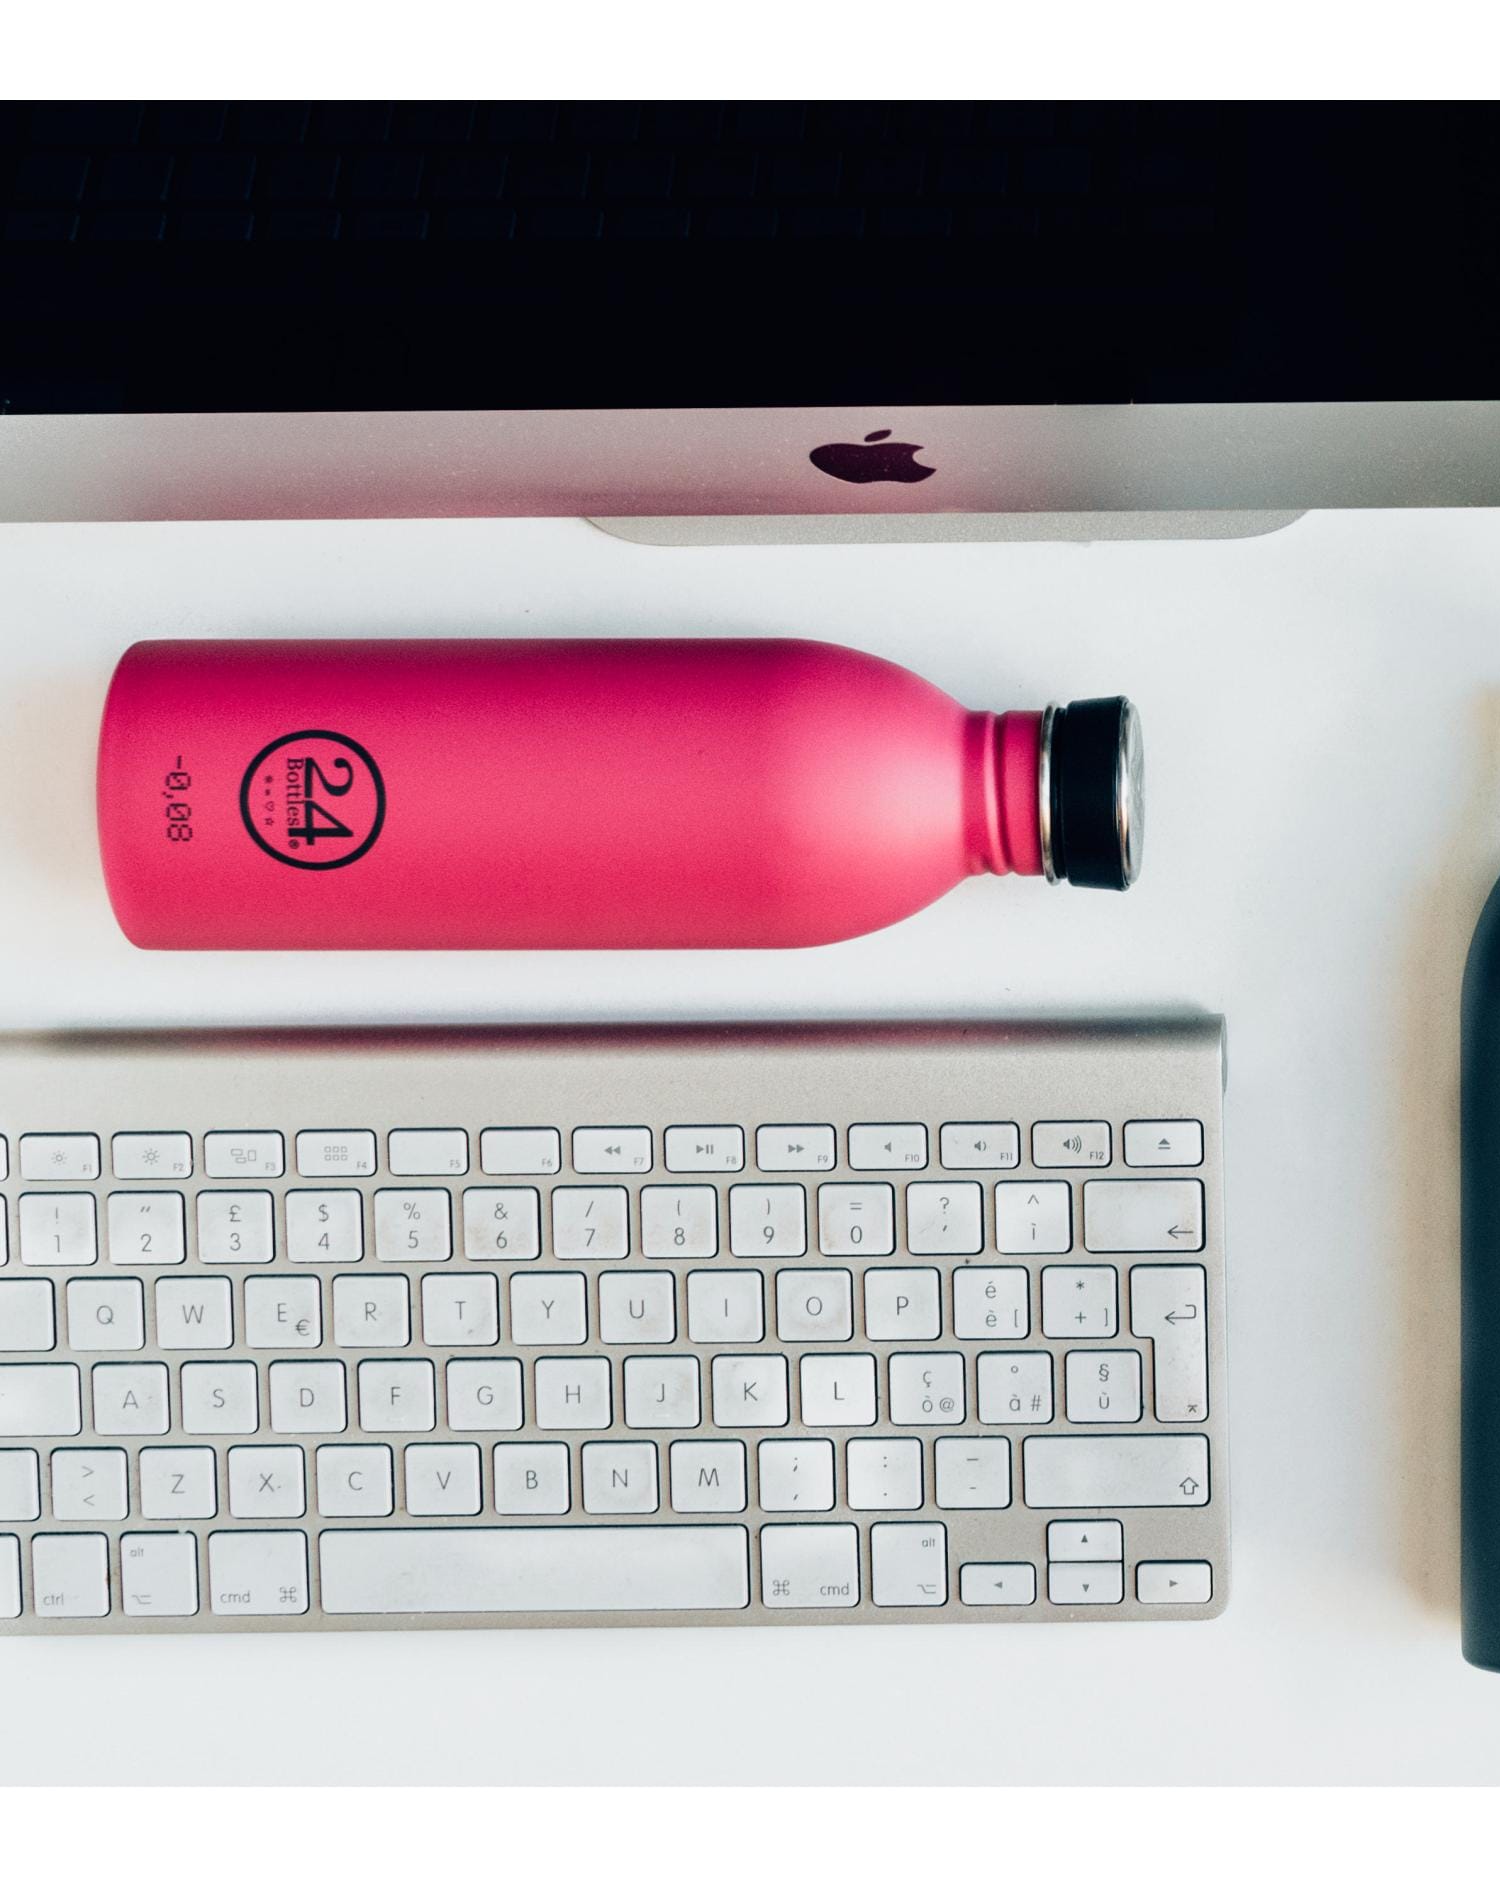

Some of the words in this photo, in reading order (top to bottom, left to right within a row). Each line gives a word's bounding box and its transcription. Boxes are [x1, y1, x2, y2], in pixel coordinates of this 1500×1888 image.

[287, 757, 354, 846] 24
[356, 1160, 368, 1169] F4
[449, 1159, 461, 1169] F5
[541, 1158, 553, 1168] F6
[633, 1156, 645, 1167] F7
[817, 1154, 829, 1164] F9
[904, 1153, 920, 1163] F10
[999, 1152, 1013, 1161] F11
[1089, 1150, 1105, 1161] F12
[82, 1163, 93, 1173] F1
[172, 1162, 185, 1172] F2
[264, 1161, 277, 1172] F3
[318, 1203, 330, 1223] $
[403, 1201, 421, 1221] %
[493, 1202, 508, 1221] &
[939, 1196, 950, 1215] ?
[54, 1234, 61, 1254] 1
[140, 1233, 153, 1253] 2
[229, 1232, 242, 1252] 3
[317, 1232, 330, 1251] 4
[407, 1230, 419, 1249] 5
[495, 1230, 508, 1250] 6
[585, 1228, 596, 1248] 7
[673, 1226, 686, 1246] 8
[762, 1225, 775, 1245] 9
[850, 1225, 863, 1244] 0
[96, 1304, 114, 1325] Q
[181, 1304, 205, 1325] W
[277, 1302, 288, 1323] E
[364, 1301, 377, 1321] R
[454, 1300, 467, 1321] T
[541, 1299, 555, 1320] Y
[628, 1299, 645, 1320] U
[805, 1296, 823, 1317] O
[896, 1295, 910, 1316] P
[295, 1318, 310, 1337] €
[122, 1389, 140, 1409] A
[212, 1388, 226, 1409] S
[299, 1387, 315, 1408] D
[390, 1386, 401, 1406] F
[476, 1385, 494, 1406] G
[565, 1384, 581, 1404] H
[656, 1383, 665, 1403] J
[743, 1381, 758, 1402] K
[833, 1381, 844, 1401] L
[938, 1397, 955, 1413] @
[1030, 1394, 1042, 1412] #
[171, 1473, 185, 1495] Z
[258, 1473, 275, 1493] X
[347, 1471, 363, 1491] C
[436, 1471, 452, 1491] V
[525, 1469, 539, 1490] B
[612, 1468, 629, 1488] N
[698, 1467, 720, 1487] M
[129, 1546, 145, 1558] alt
[921, 1537, 936, 1548] alt
[219, 1590, 251, 1604] cmd
[819, 1582, 850, 1596] cmd
[42, 1593, 64, 1607] ctrl
